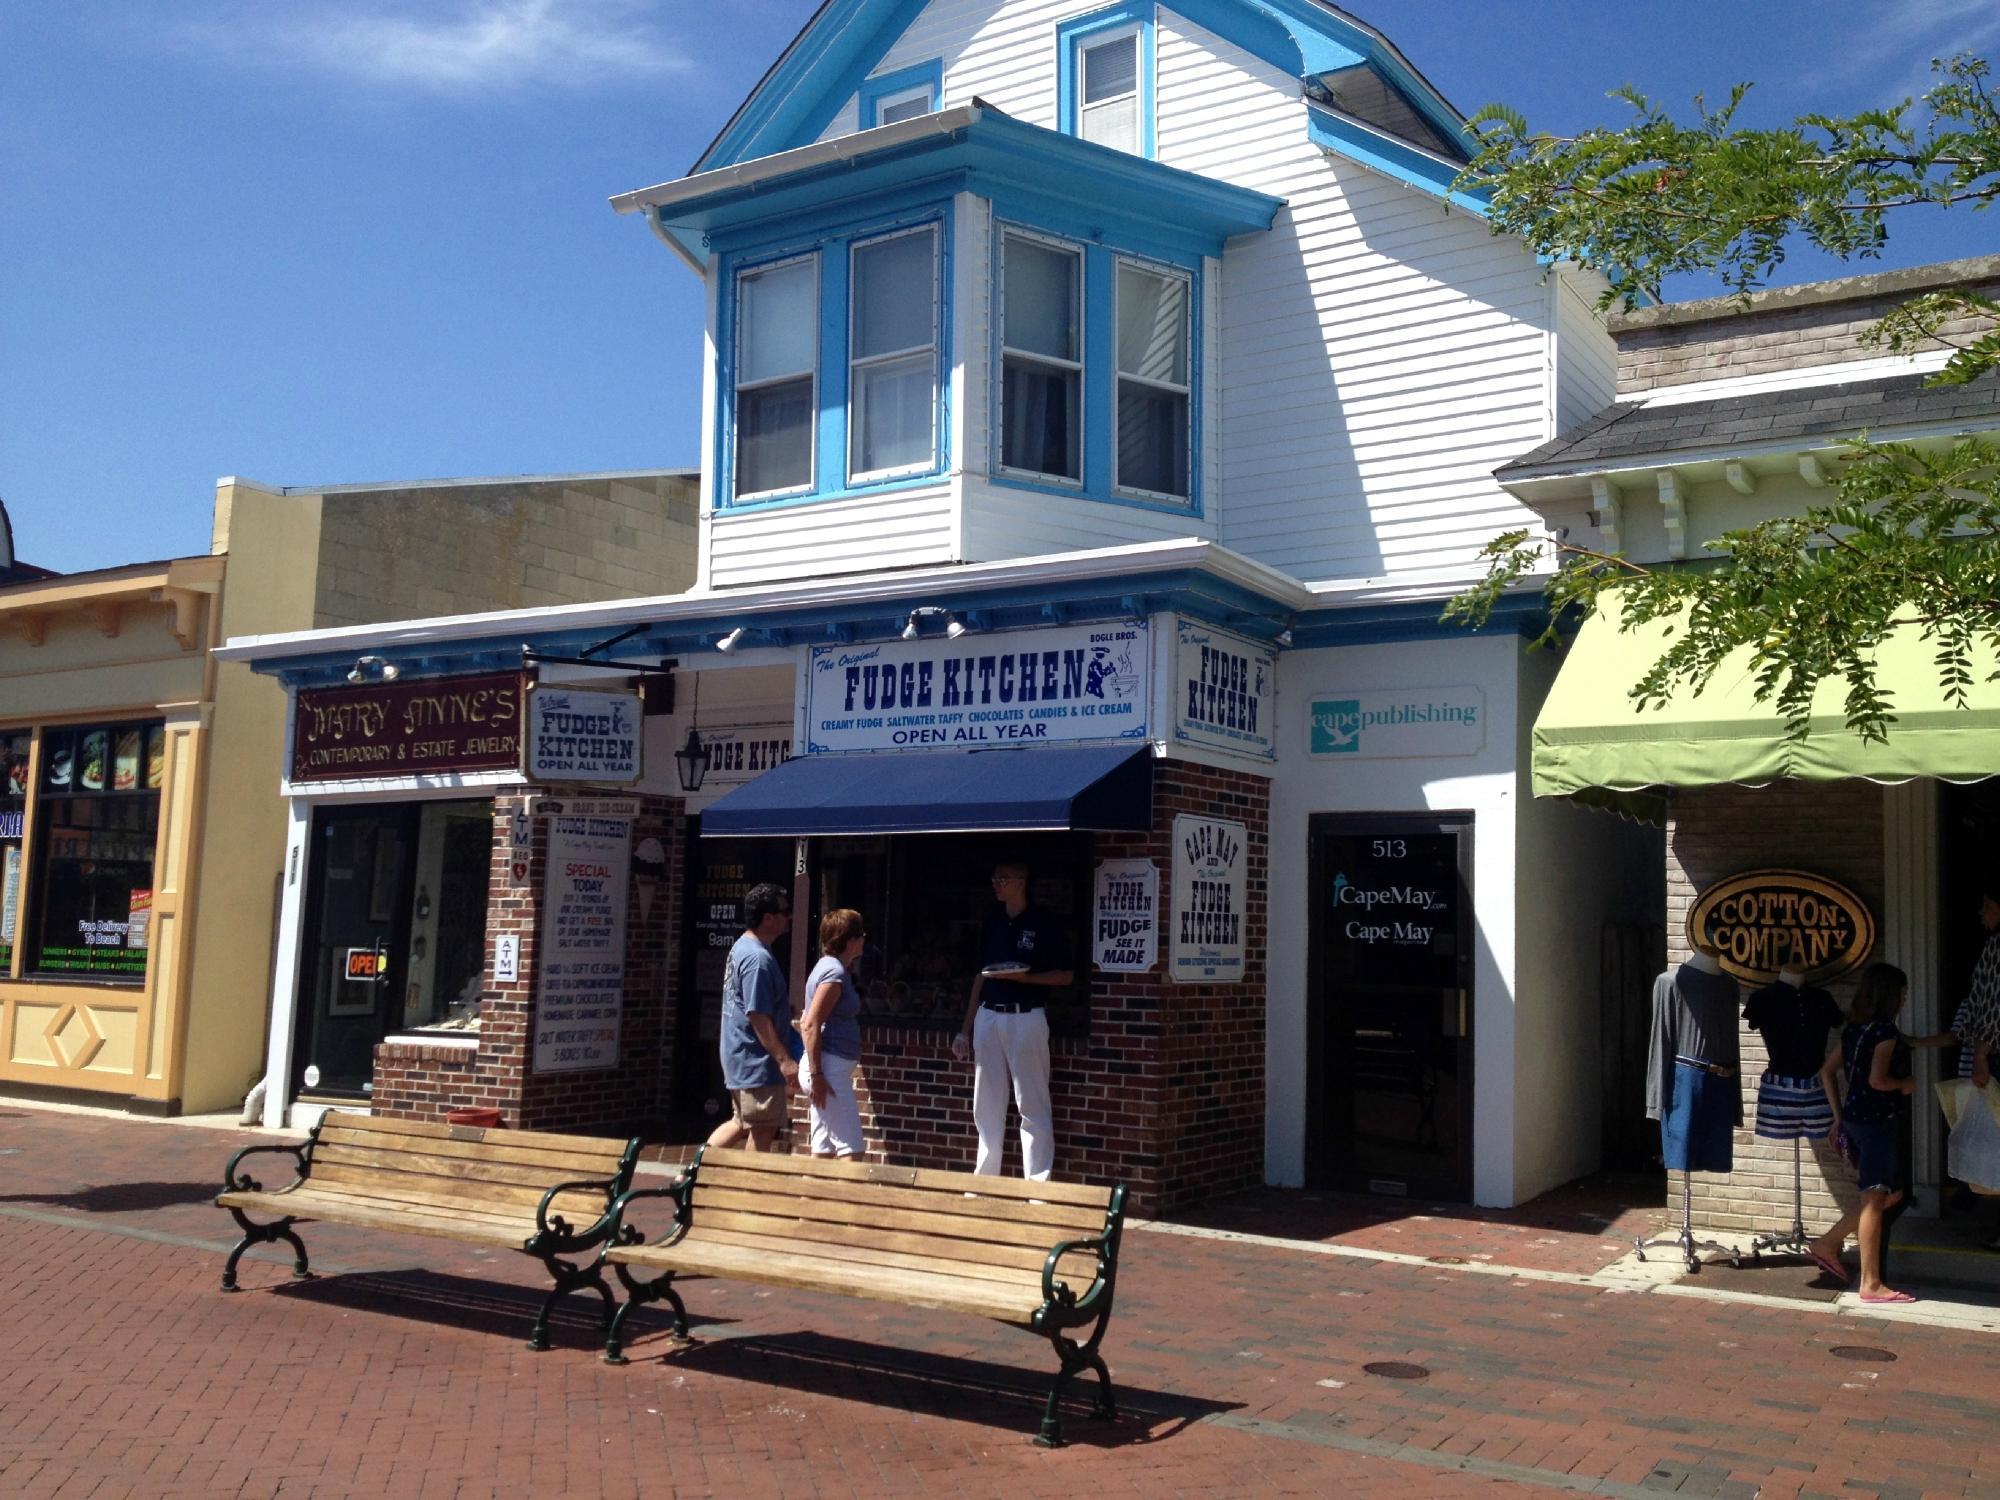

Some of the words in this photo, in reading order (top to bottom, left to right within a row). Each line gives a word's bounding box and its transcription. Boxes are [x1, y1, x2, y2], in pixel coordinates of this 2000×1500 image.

[1090, 633, 1113, 642] BOGLE
[1116, 632, 1138, 641] BROS.
[817, 660, 834, 672] The
[838, 646, 880, 666] Original
[1202, 646, 1248, 693] FUDGE
[845, 661, 933, 711] FUDGE
[942, 649, 1085, 707] KITCHEN
[308, 700, 391, 741] MARY
[403, 690, 516, 734] ANNE'S
[822, 720, 854, 730] CREAMY
[857, 718, 883, 728] FUDGE
[887, 715, 935, 727] SALTWATER
[938, 712, 964, 724] TAFFY
[969, 709, 1024, 722] CHOCOLATES
[1029, 706, 1068, 719] CANDIES
[1070, 706, 1078, 717] &
[1082, 705, 1095, 716] ICE
[1098, 703, 1132, 715] CREAM
[1188, 680, 1257, 733] KITCHEN
[542, 712, 610, 735] FUDGE
[892, 729, 947, 744] OPEN
[954, 726, 988, 741] ALL
[995, 724, 1047, 738] YEAR
[310, 745, 393, 765] CONTEMPORARY
[398, 744, 405, 760] &
[412, 740, 456, 759] ESTATE
[461, 736, 518, 756] JEWELRY
[538, 736, 633, 759] KITCHEN
[704, 742, 744, 771] UDGE
[538, 760, 573, 770] OPEN
[577, 761, 599, 771] ALL
[603, 762, 633, 771] YEAR
[557, 818, 586, 835] FUDGE
[588, 819, 629, 838] KITCHEN
[1186, 825, 1212, 866] CAPE
[1216, 828, 1239, 868] MAY
[1371, 840, 1407, 858] 513
[566, 864, 612, 878] SPECIAL
[706, 864, 744, 879] FUDGE
[1206, 857, 1219, 867] AND
[573, 879, 604, 892] TODAY
[1108, 882, 1144, 896] FUDGE
[1100, 896, 1152, 910] KITCHEN
[1192, 881, 1231, 913] FUDGE
[710, 904, 736, 920] OPEN
[1720, 893, 1839, 927] COTTON
[79, 920, 96, 932] Free
[97, 920, 129, 935] Delivery
[1099, 920, 1152, 942] FUDGE
[1181, 912, 1239, 945] KITCHEN
[1345, 921, 1390, 944] Cape
[1393, 922, 1434, 945] May
[85, 933, 95, 945] To
[96, 933, 121, 945] Beach
[708, 932, 735, 947] 9am
[1115, 938, 1133, 948] SEE
[1135, 939, 1146, 948] IT
[1713, 926, 1848, 972] COMPANY
[501, 940, 512, 968] ATM
[1103, 950, 1145, 964] MADE
